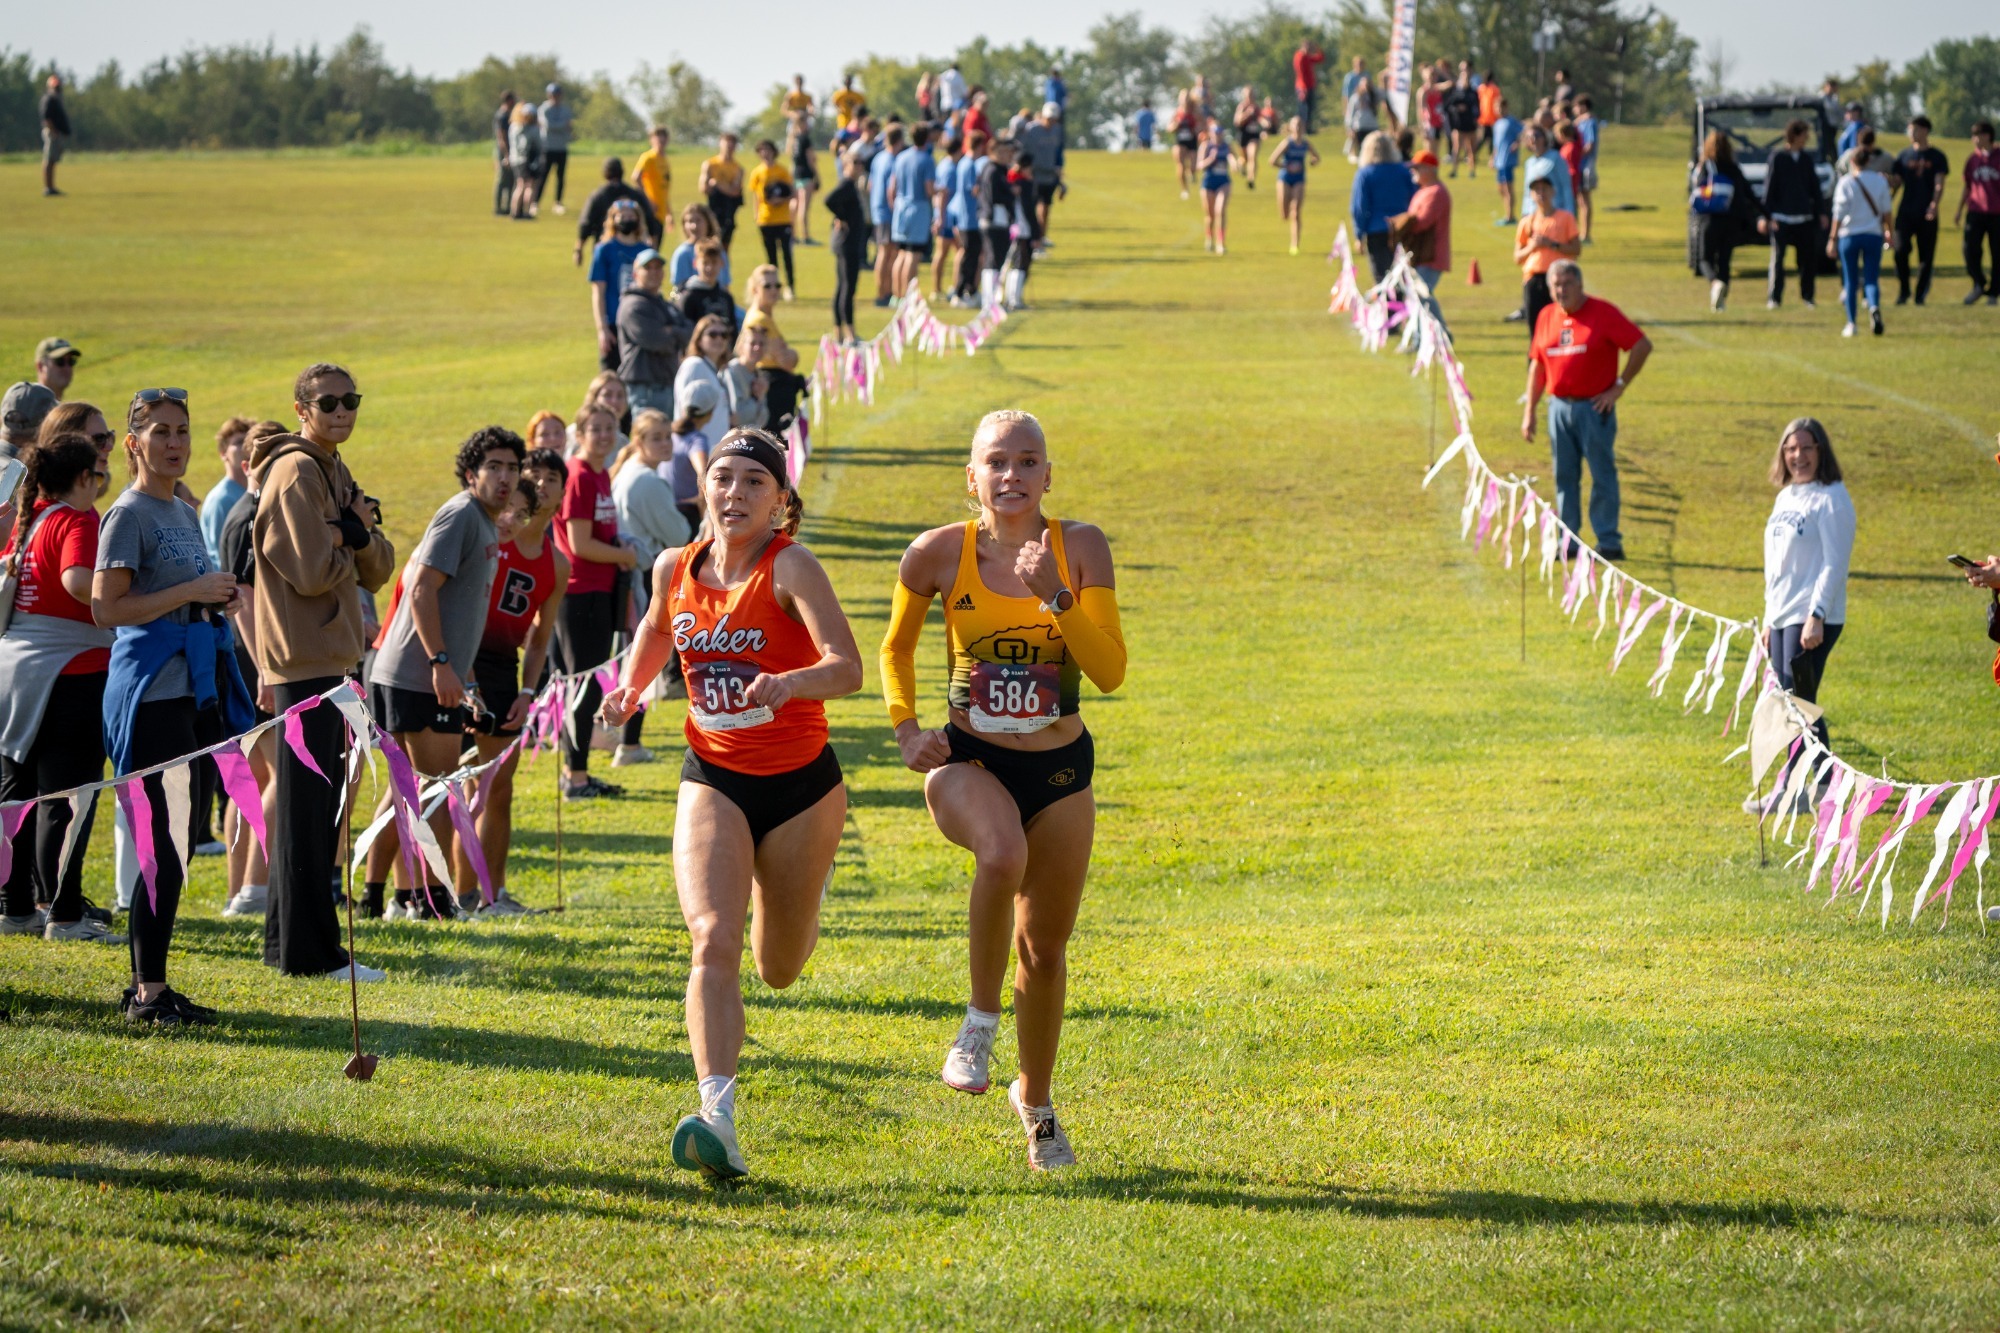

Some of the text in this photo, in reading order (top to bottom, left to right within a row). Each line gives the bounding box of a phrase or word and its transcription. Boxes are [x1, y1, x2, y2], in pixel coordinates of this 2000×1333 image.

[721, 444, 754, 452] adidas
[497, 567, 536, 617] B
[672, 611, 768, 654] Baker
[994, 638, 1041, 664] OU
[704, 677, 748, 711] 513
[989, 680, 1040, 713] 586
